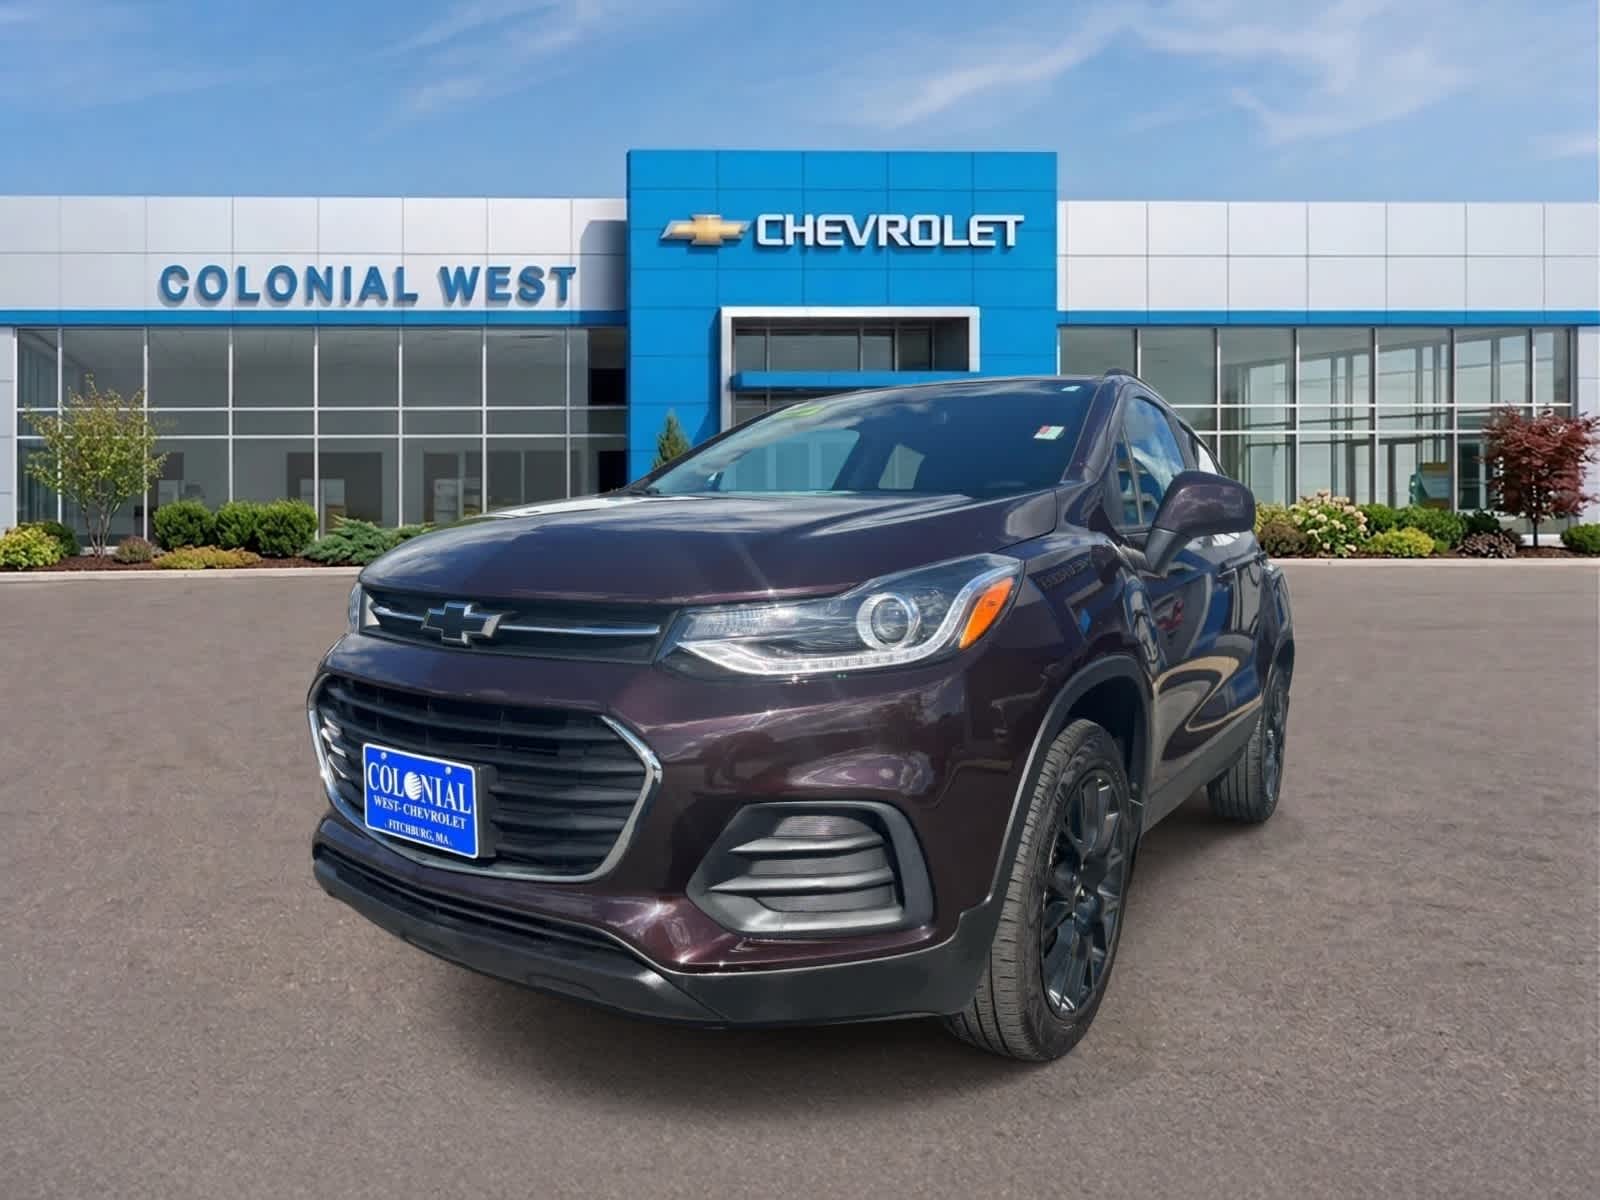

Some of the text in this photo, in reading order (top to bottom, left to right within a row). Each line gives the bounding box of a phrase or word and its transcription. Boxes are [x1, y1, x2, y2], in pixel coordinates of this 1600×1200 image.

[756, 214, 1024, 247] CHEVROLET
[159, 265, 577, 302] COLONIAL WEST
[368, 762, 472, 814] COLONIAL
